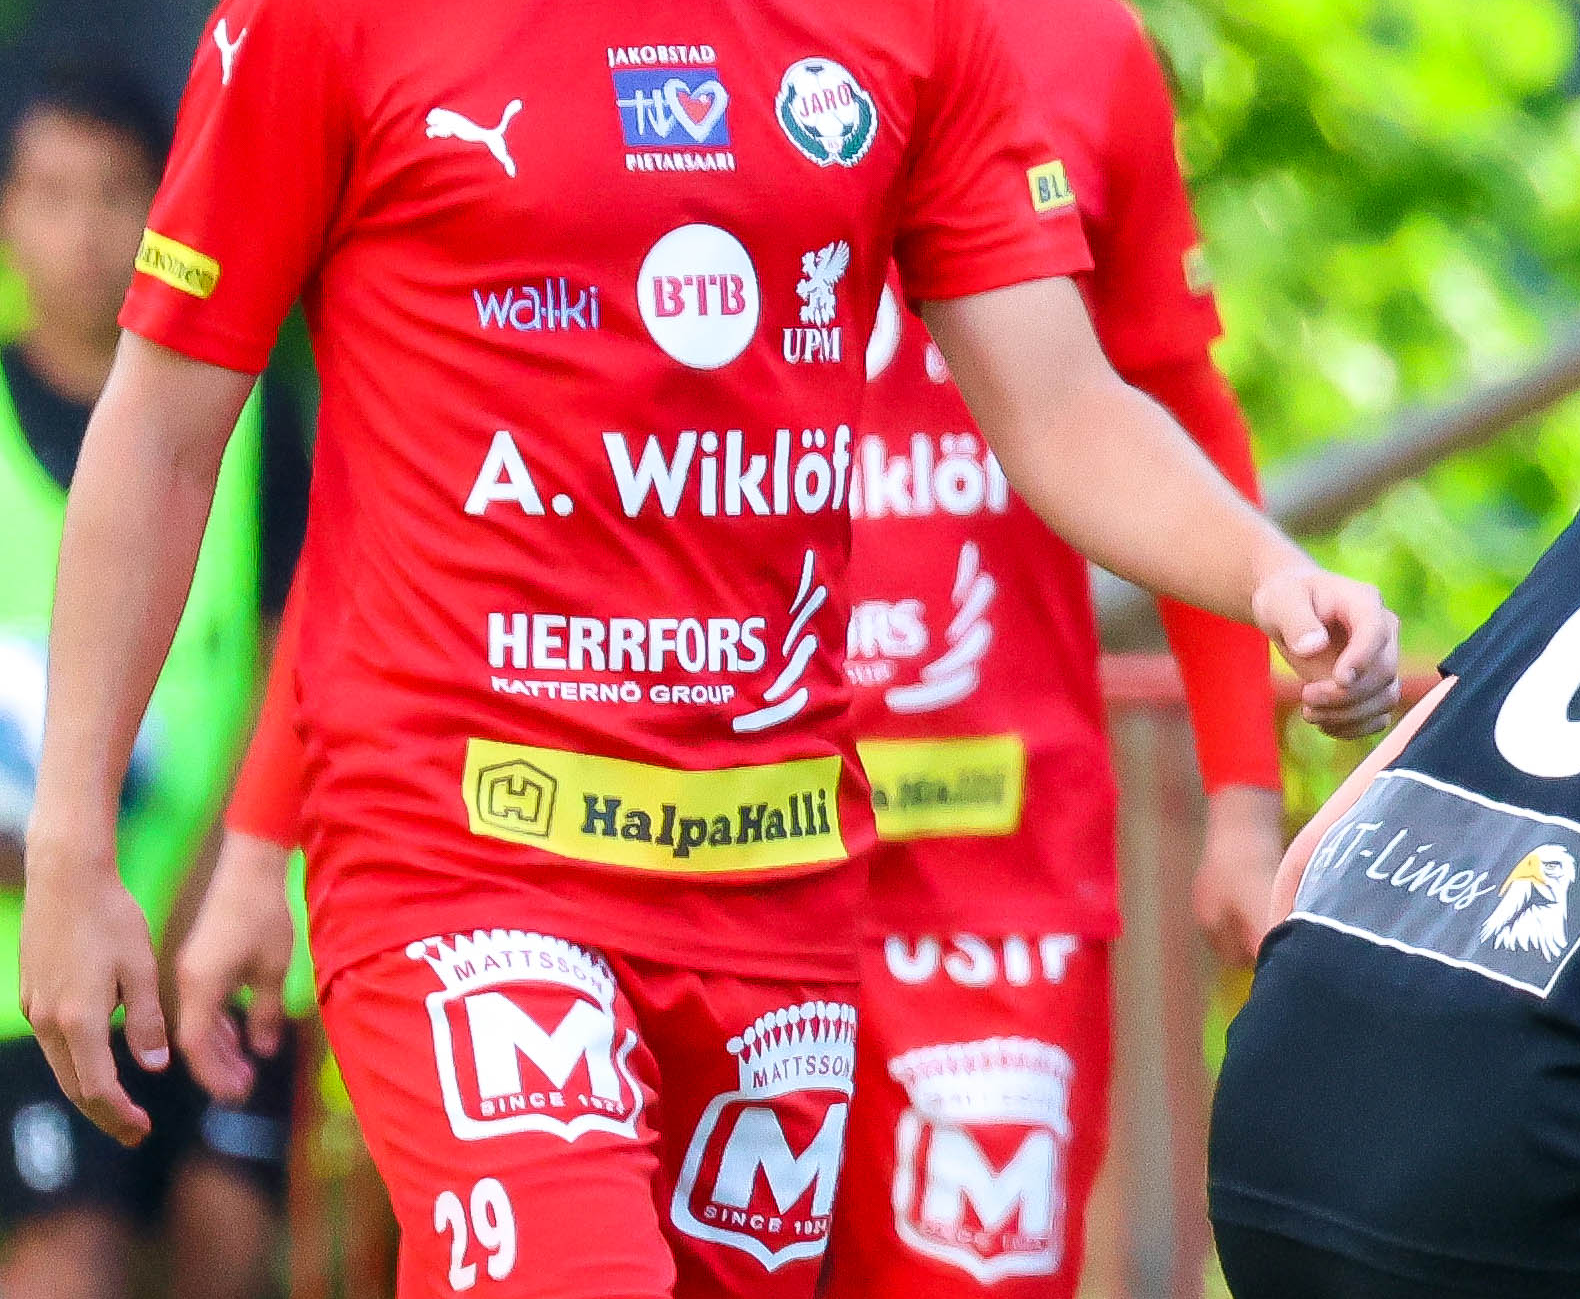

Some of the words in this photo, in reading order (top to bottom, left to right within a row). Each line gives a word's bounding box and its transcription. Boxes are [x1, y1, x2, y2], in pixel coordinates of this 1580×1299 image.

[608, 44, 717, 68] JAKOBSTAD
[798, 83, 852, 118] JARO
[473, 277, 600, 331] walki
[653, 274, 746, 318] BTB
[783, 327, 842, 364] UPM
[464, 429, 574, 517] A.
[602, 423, 851, 518] Wiklöf
[487, 612, 767, 672] HERRFORS
[490, 675, 642, 704] KATTERNÖ
[649, 684, 736, 705] GROUP
[581, 788, 831, 859] HalpaHalli
[453, 949, 603, 995] MATTSSON
[480, 1091, 566, 1117] SINCE
[435, 1177, 517, 1292] 29
[704, 1204, 783, 1234] SINCE
